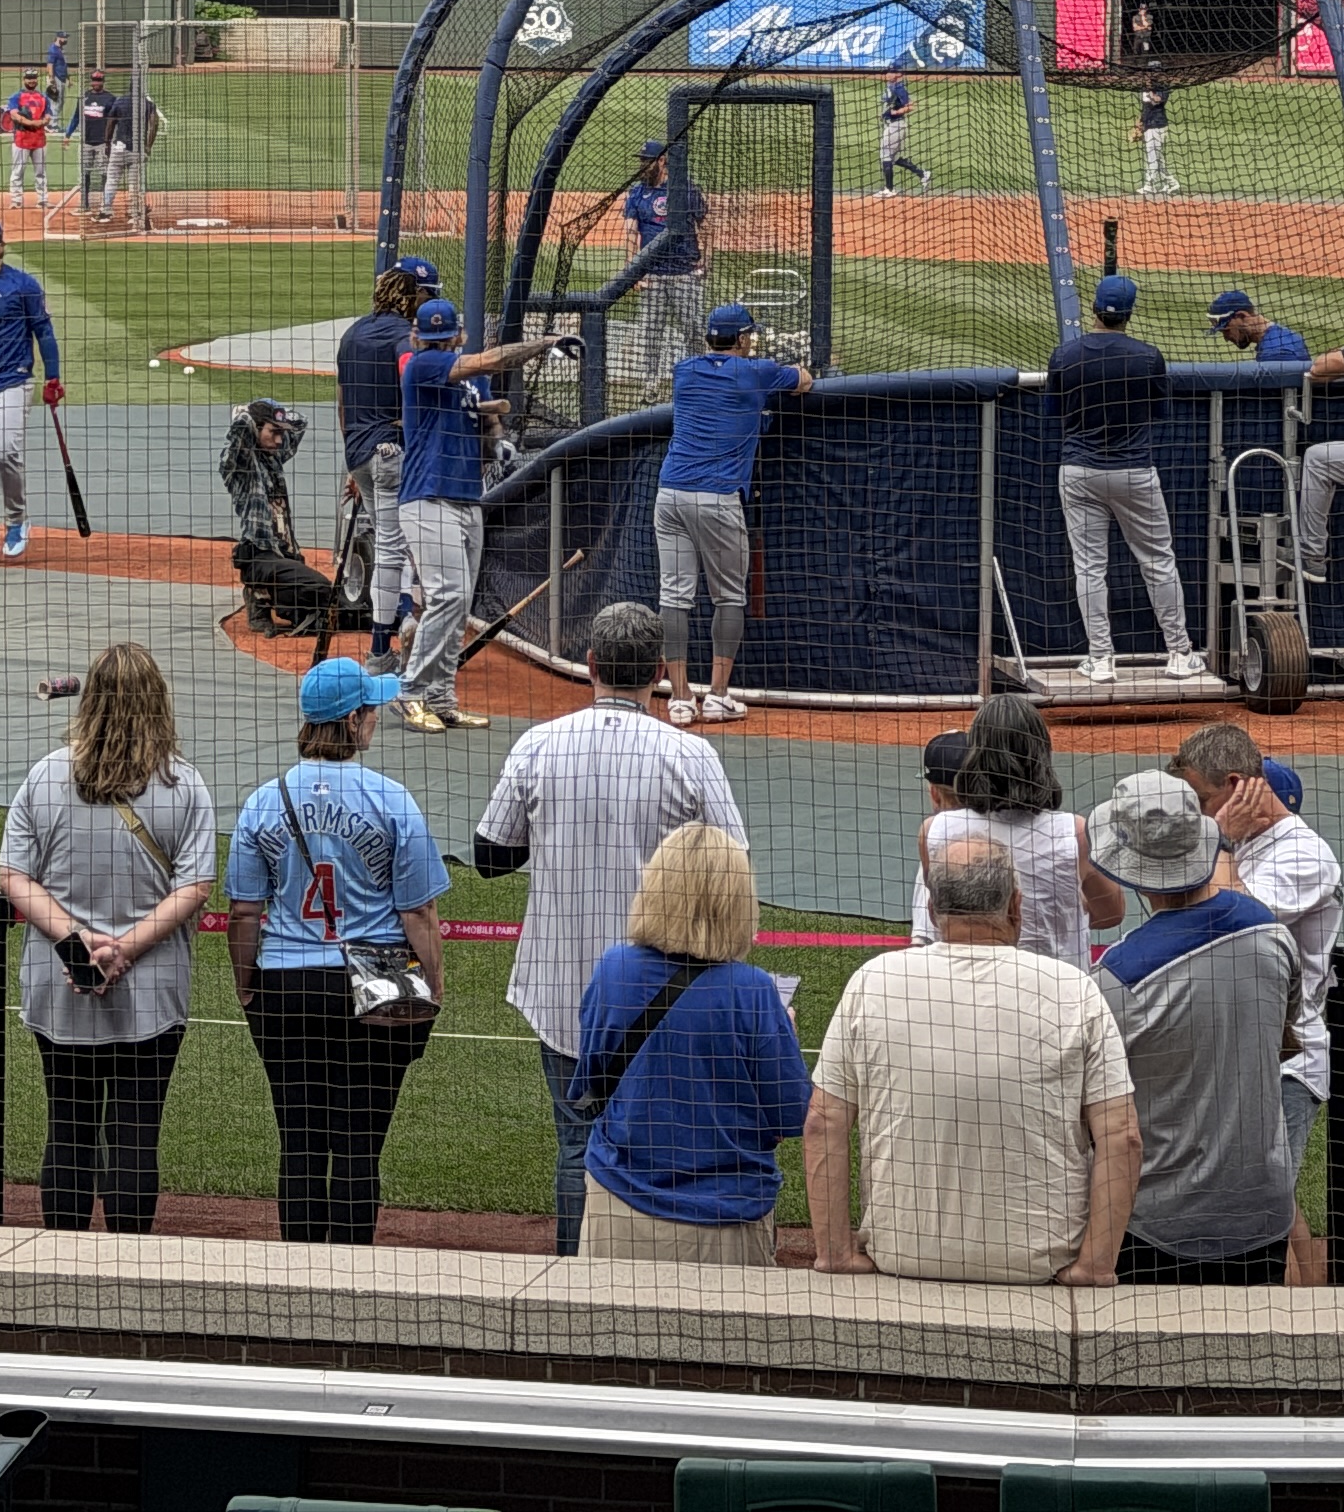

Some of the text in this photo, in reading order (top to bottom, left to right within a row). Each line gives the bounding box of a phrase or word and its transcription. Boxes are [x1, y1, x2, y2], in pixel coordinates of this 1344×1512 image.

[302, 861, 344, 942] 4
[455, 925, 519, 936] T-MOBILE PARK
